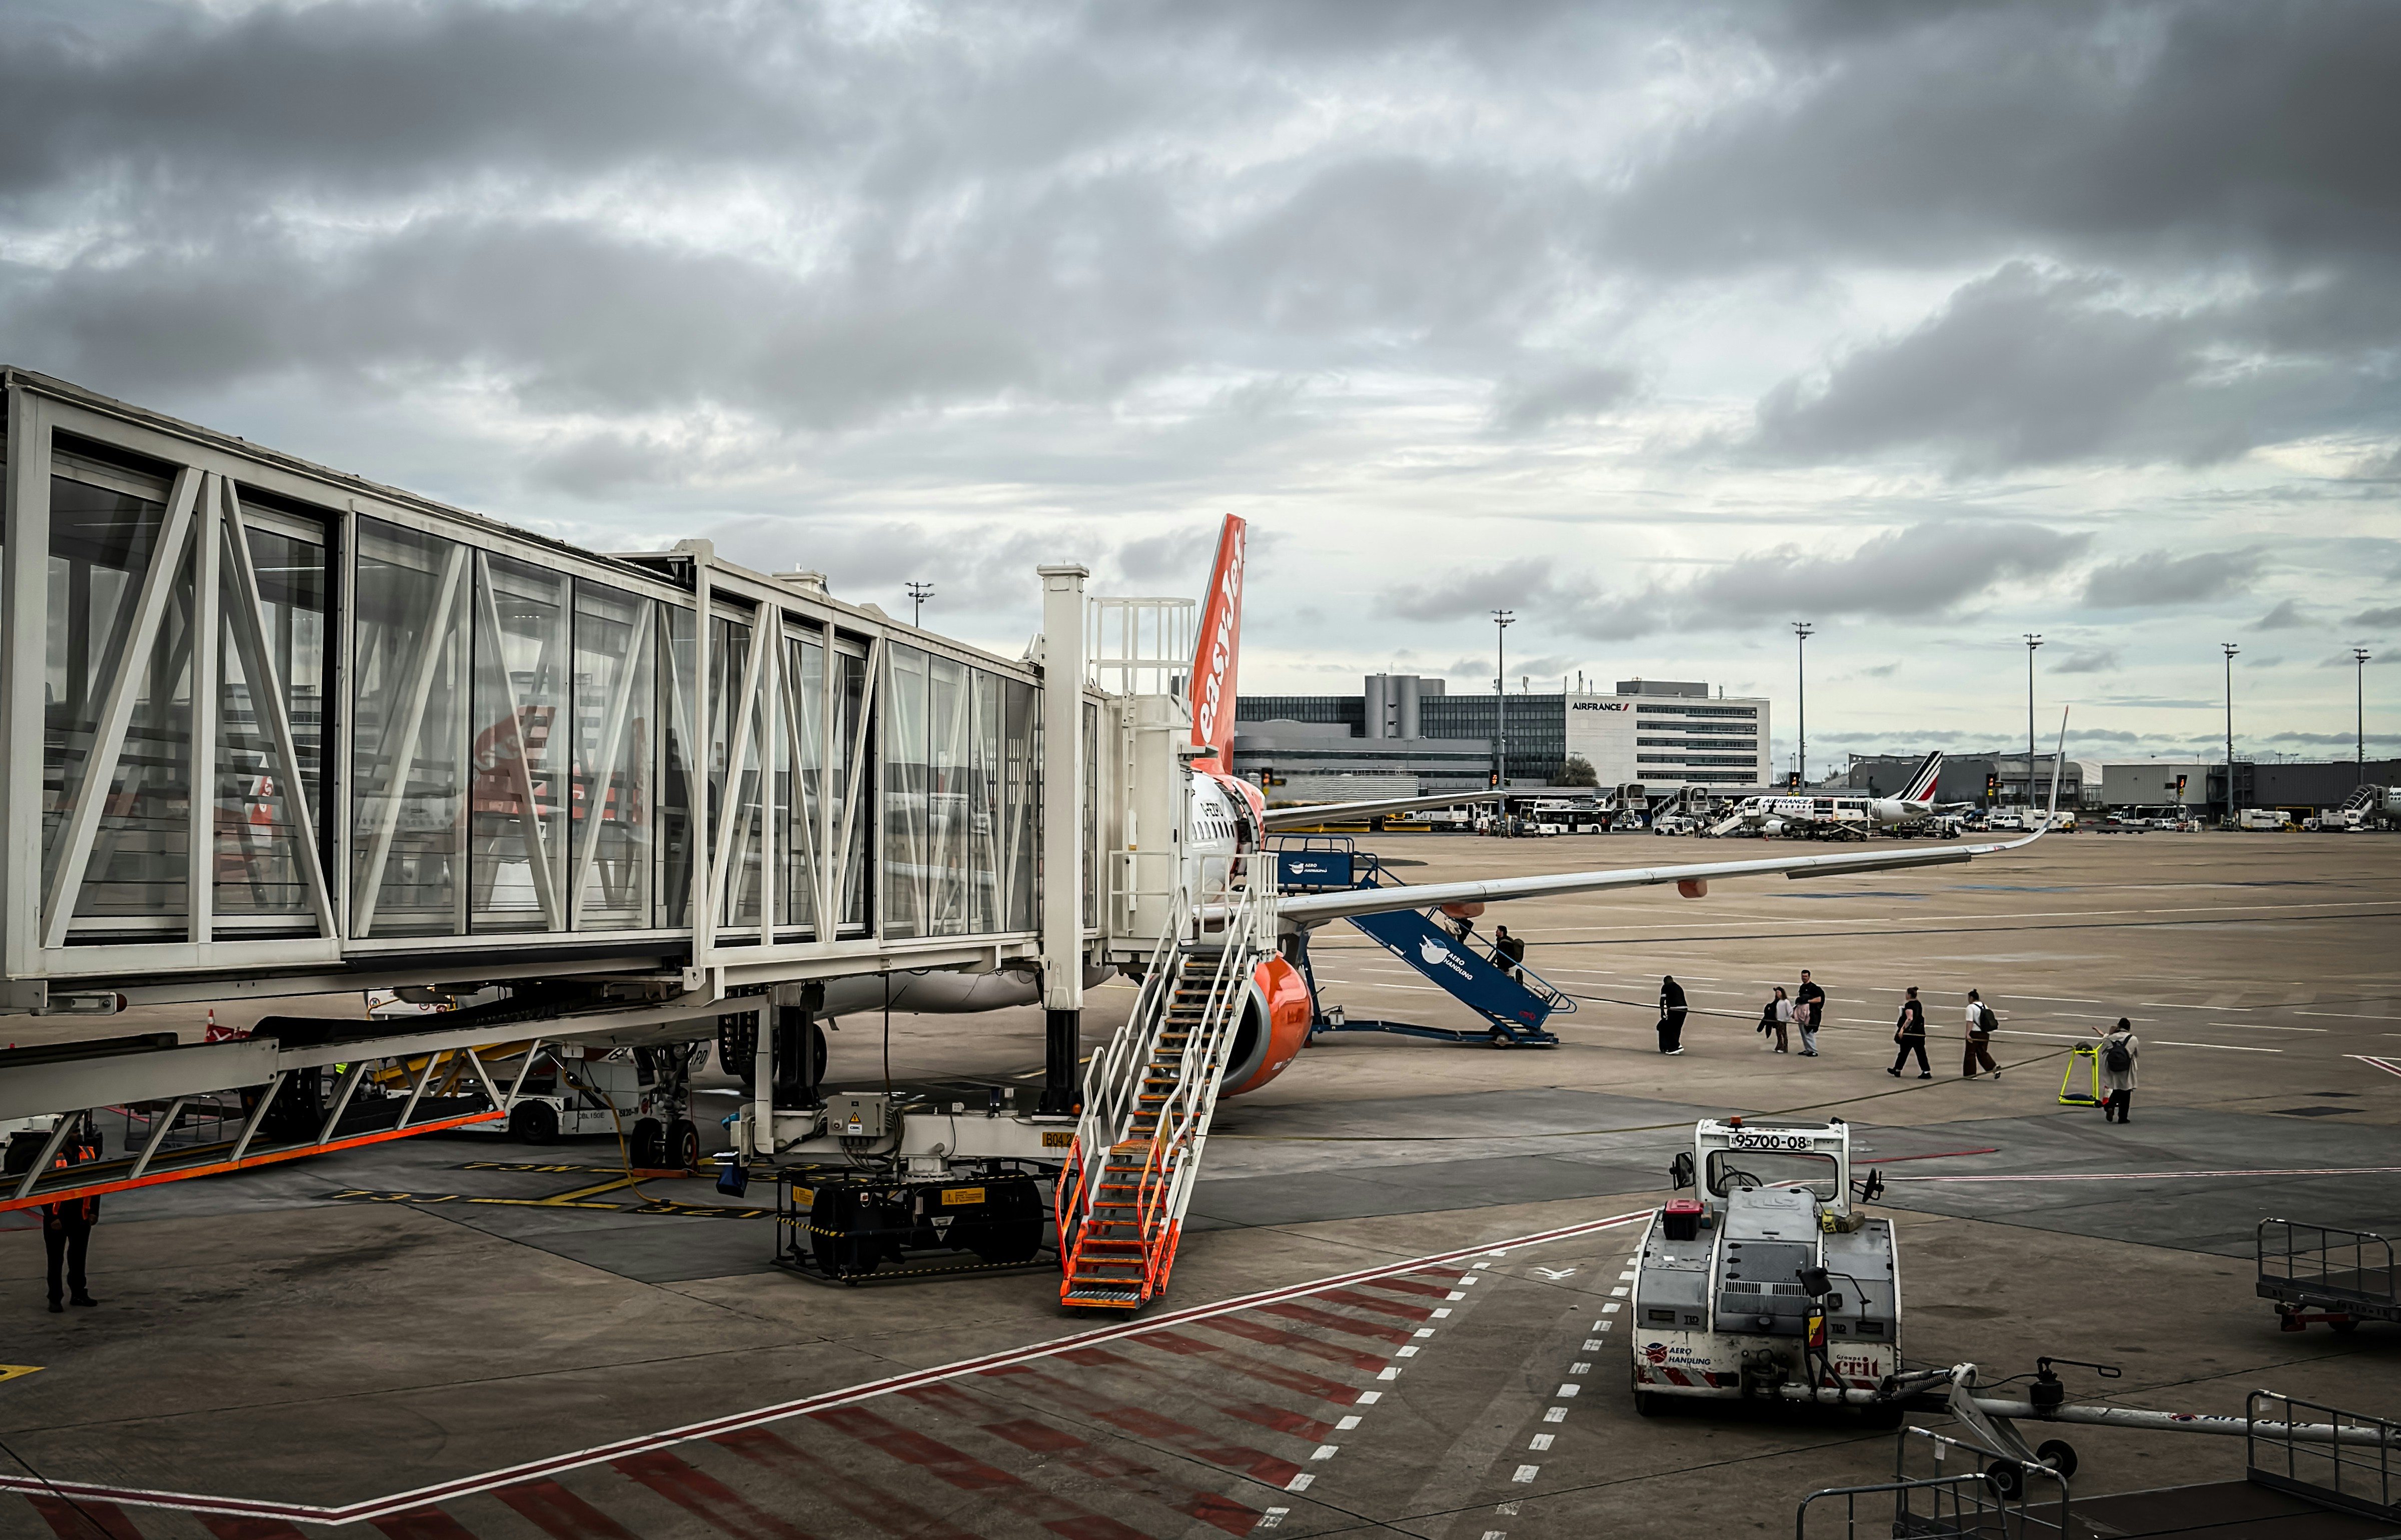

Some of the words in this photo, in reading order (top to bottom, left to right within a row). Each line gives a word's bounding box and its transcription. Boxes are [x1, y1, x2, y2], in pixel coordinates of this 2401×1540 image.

[1573, 703, 1621, 711] AIRFRANCE
[1448, 953, 1465, 966] AERO
[1443, 958, 1473, 980] HANDLING
[690, 1050, 708, 1065] PD
[1736, 1134, 1806, 1149] 95700-08
[1684, 1315, 1699, 1325] TLD
[1831, 1323, 1847, 1334] TLD
[1669, 1347, 1692, 1355] AERO
[1669, 1356, 1711, 1365] HANDLING
[1834, 1356, 1880, 1377] crit
